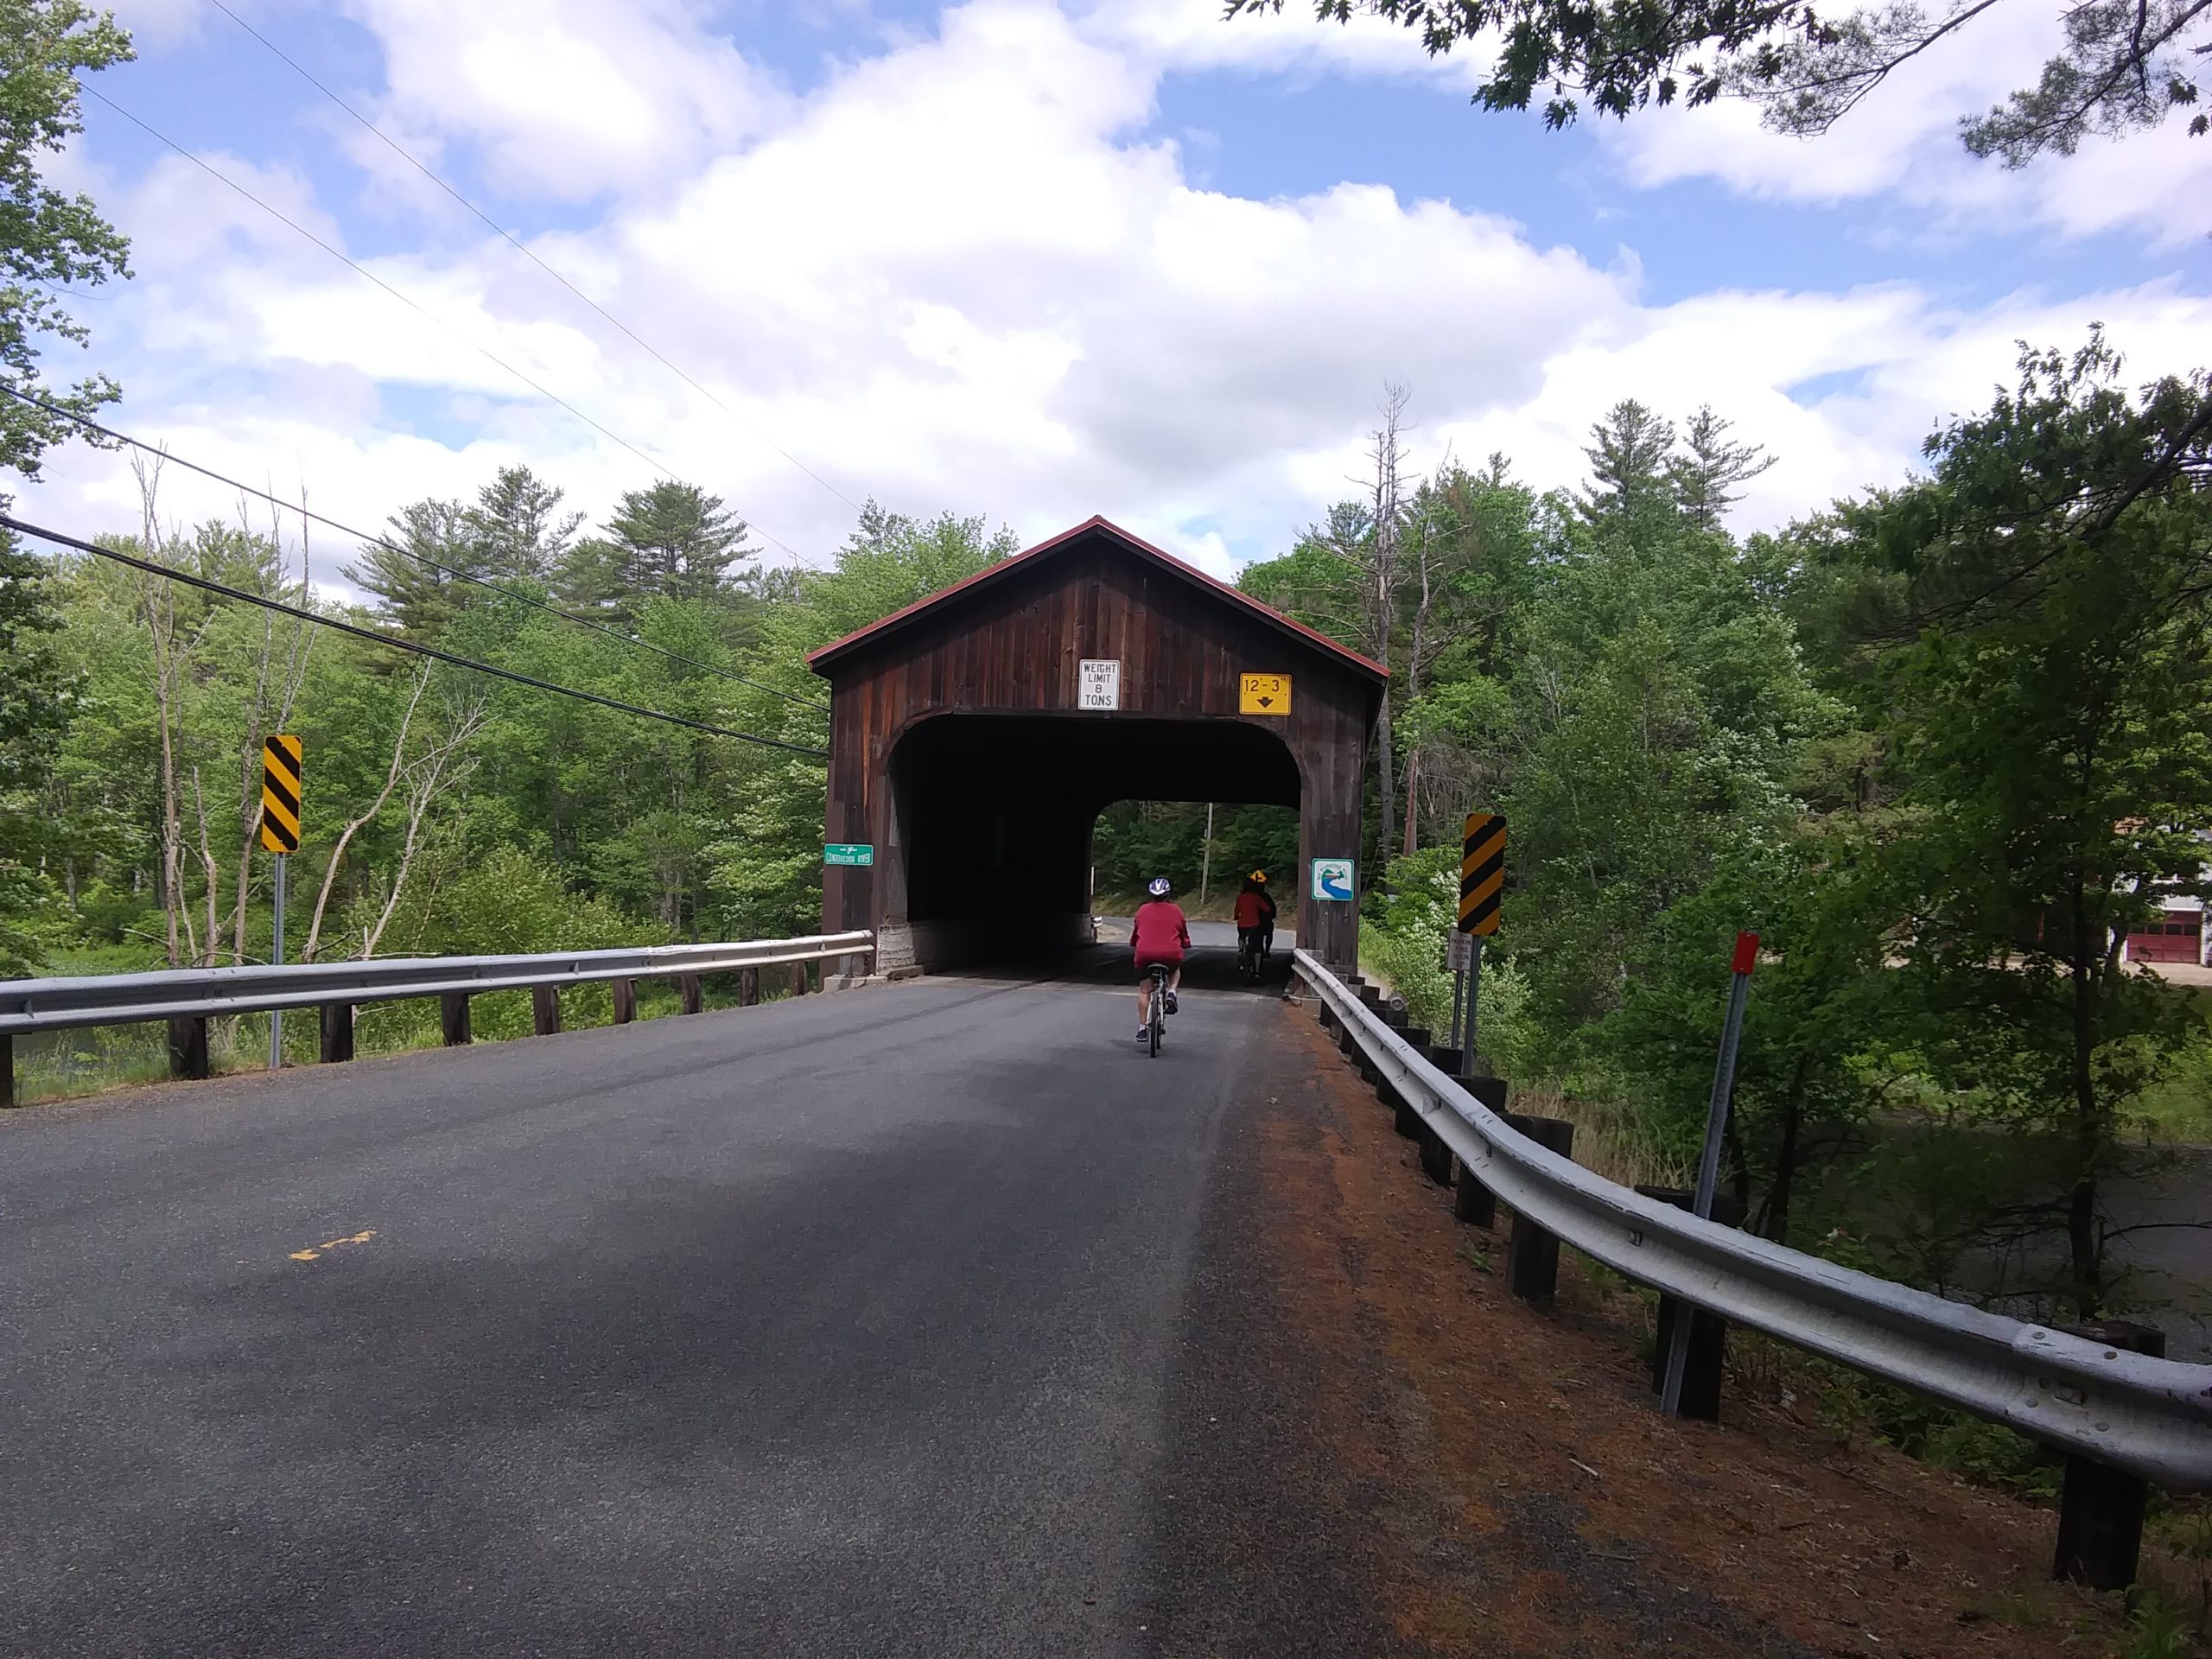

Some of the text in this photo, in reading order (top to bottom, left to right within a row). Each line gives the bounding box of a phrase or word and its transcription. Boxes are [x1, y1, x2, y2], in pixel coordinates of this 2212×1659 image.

[1084, 663, 1117, 674] WEIGHT
[1088, 673, 1112, 683] LIMIT
[1095, 683, 1103, 694] 8
[1084, 694, 1113, 707] TONS
